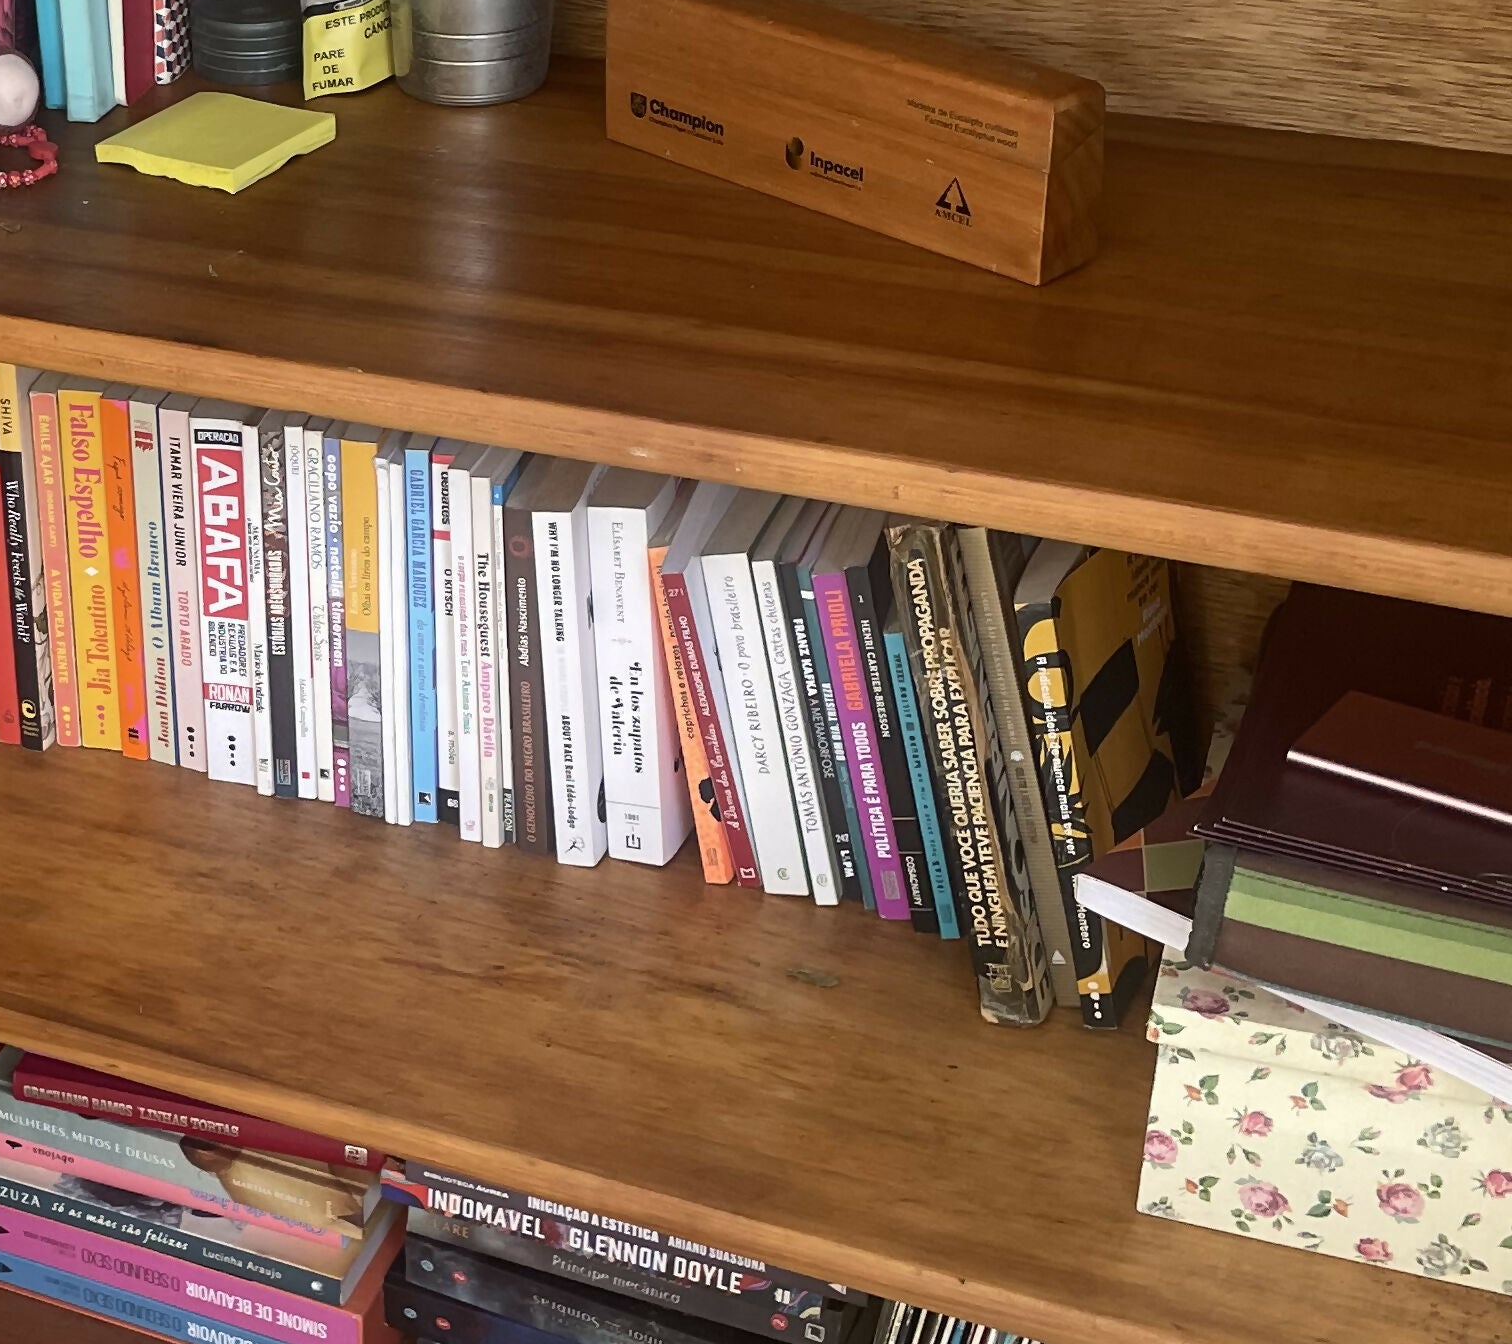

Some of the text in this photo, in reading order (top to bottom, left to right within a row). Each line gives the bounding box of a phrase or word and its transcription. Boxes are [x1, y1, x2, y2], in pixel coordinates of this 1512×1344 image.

[325, 15, 357, 30] ESTE
[314, 48, 345, 62] PARE
[322, 64, 340, 75] DE
[312, 77, 355, 92] FUMAR
[649, 99, 724, 137] Champion
[809, 151, 865, 183] Inpacel
[934, 208, 973, 228] AMCEL
[0, 398, 14, 436] SHIVA
[40, 455, 54, 485] AJAR
[68, 403, 105, 559] Falso Espelho
[169, 436, 185, 521] ITAMAR VIEIRA
[409, 469, 425, 516] GABRIEL
[5, 480, 25, 586] Who Feeds
[201, 454, 244, 615] ABAFA
[306, 447, 323, 570] GRACILIANO RAMOS
[326, 495, 342, 534] vazio
[548, 521, 559, 541] WHY
[147, 521, 160, 578] Branco
[551, 559, 561, 572] NO
[50, 582, 65, 638] VIDA PELA
[445, 578, 454, 617] KITSCH
[476, 552, 491, 657] The Houseguest
[551, 574, 563, 606] LONGER
[85, 584, 112, 695] Jia Tolentino
[177, 590, 193, 667] TORTO ARADO
[331, 600, 345, 667] timerman
[516, 576, 530, 667] Abdias Nascimento
[554, 608, 565, 642] TALKING
[678, 615, 692, 641] FILHO
[722, 575, 771, 775] DARCY RIBEIRO povo brasileiro
[824, 589, 864, 711] GABRIELA PRIOLI
[154, 656, 171, 749] Joan Didion
[208, 683, 251, 704] RONAN
[672, 645, 695, 739] caprichos relaxos
[762, 580, 820, 833] TOMÁS ANTÔNIO GONZAGA Cartas chilenas
[792, 618, 835, 779] FRANZ KAFKA METAMORFOSE
[860, 619, 891, 738] HENRI CARTIER-BRESSON
[478, 660, 495, 758] Amparo Dávila
[560, 714, 573, 743] ABOUT
[609, 675, 628, 756] de Valeria
[628, 661, 645, 774] En los zapatos
[520, 680, 537, 834] GENOCÍDIO DO NEGRO BRASILEIRO
[906, 558, 992, 947] TUDO QUE QUERIA SABER SOBRE PROPAGANDA
[851, 721, 892, 859] POLÍTICA É PARA TODOS
[953, 703, 994, 863] TEVE PARA
[504, 792, 513, 832] PEARSON
[835, 832, 849, 843] 242
[1057, 793, 1076, 856] mais ver
[23, 1084, 239, 1138] GRACILIANO RAMOS LINHAS TORTAS
[71, 1131, 112, 1153] MITOS
[125, 1146, 176, 1170] DEUSAS
[68, 1208, 83, 1219] as
[121, 1222, 141, 1237] são
[142, 1229, 189, 1252] felizes
[202, 1247, 282, 1280] Lucinha Araujo
[568, 1226, 743, 1295] GLENNON DOYLE
[80, 1247, 328, 1340] SIMONE DE BEAUVOIR SEGUNDO SEXO
[82, 1286, 115, 1310] SEXO
[115, 1297, 171, 1329] SEGUNDO
